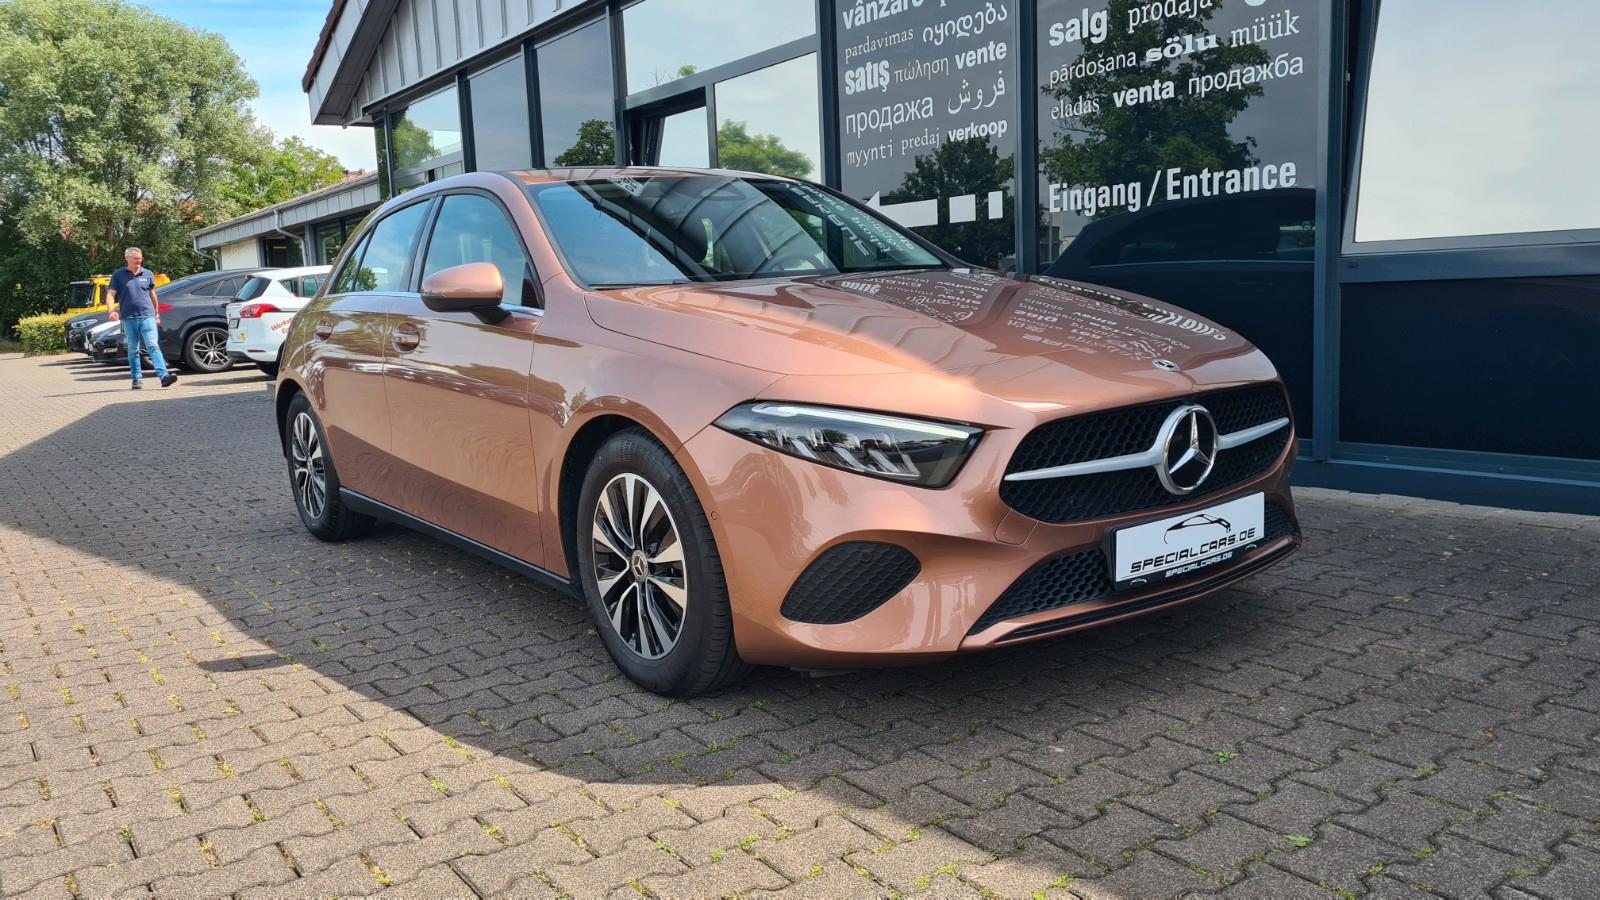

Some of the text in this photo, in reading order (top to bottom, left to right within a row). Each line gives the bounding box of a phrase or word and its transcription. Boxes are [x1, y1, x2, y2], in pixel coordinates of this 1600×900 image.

[845, 28, 914, 64] pardavimas
[1049, 8, 1108, 47] salg
[894, 57, 949, 83] πώληση
[955, 40, 1008, 70] vente
[1049, 9, 1300, 90] pārdošana sölu müük
[844, 60, 890, 95] satış
[948, 70, 1006, 114] فروش
[1188, 53, 1304, 97] продажба
[846, 96, 934, 138] продажа
[1051, 79, 1175, 120] eladás venta
[847, 119, 1008, 167] myynti predaj verkoop
[1049, 181, 1141, 216] Eingang
[1166, 161, 1297, 200] Entrance
[1130, 527, 1256, 574] SPECIALCARS.DE
[1165, 551, 1233, 578] SPECIALCARS.DE
